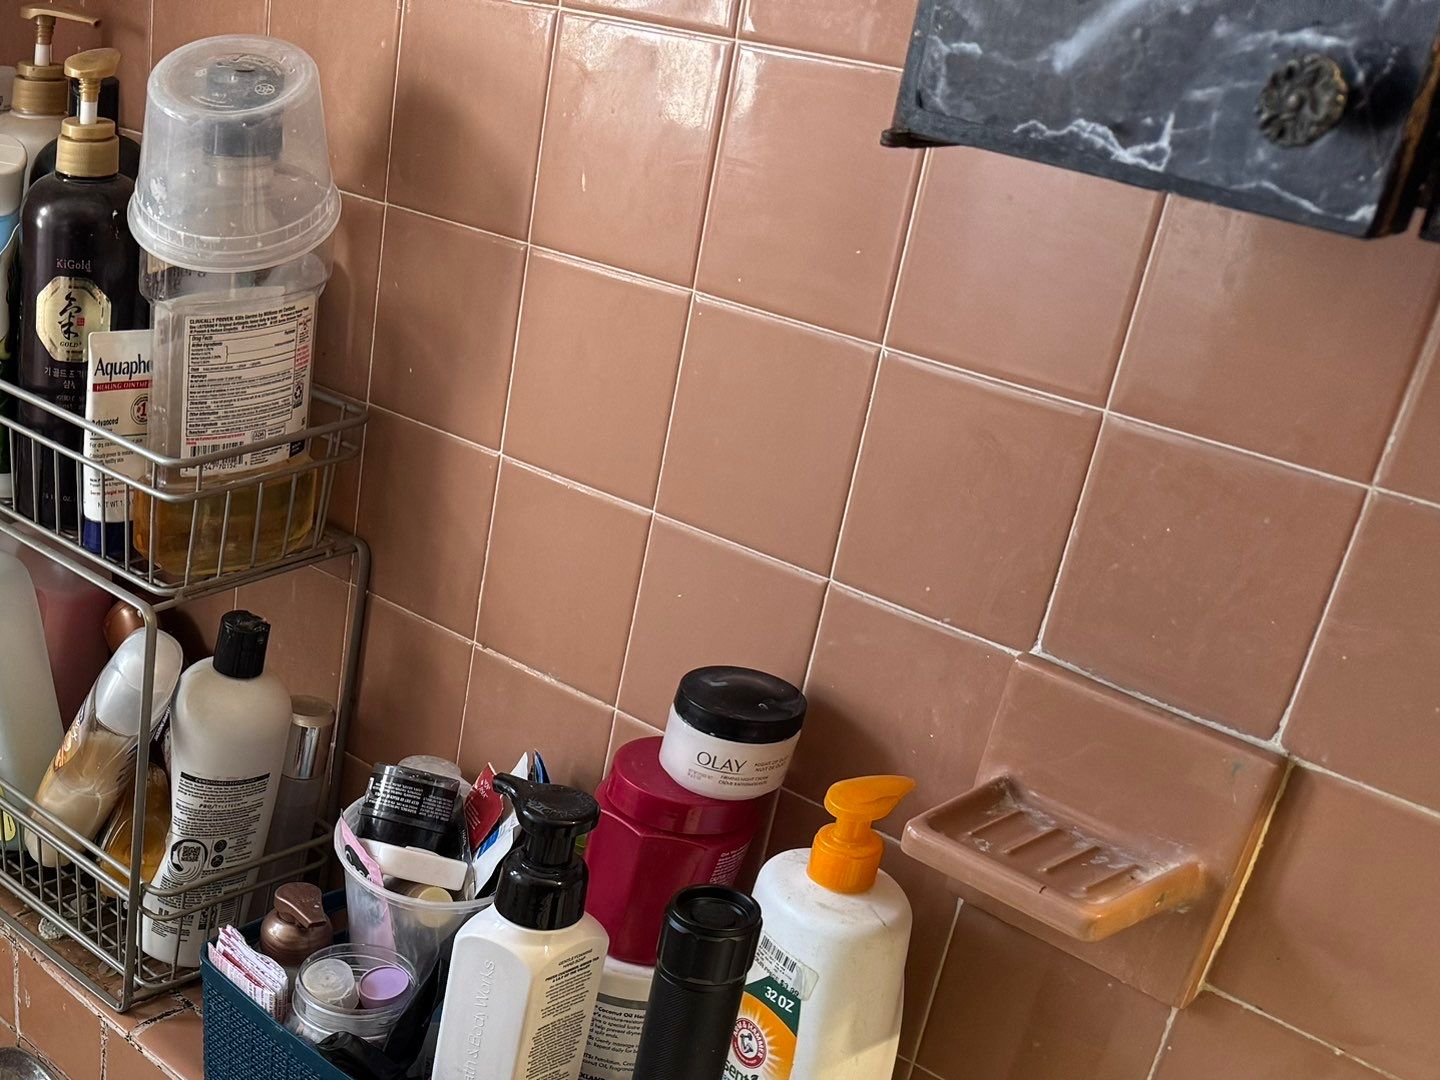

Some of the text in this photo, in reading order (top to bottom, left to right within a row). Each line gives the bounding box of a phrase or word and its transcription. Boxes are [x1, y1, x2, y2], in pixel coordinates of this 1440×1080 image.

[696, 751, 748, 773] OLAY
[474, 959, 497, 1008] Works
[598, 1006, 623, 1017] Coconut
[764, 985, 795, 1013] 32 OZ
